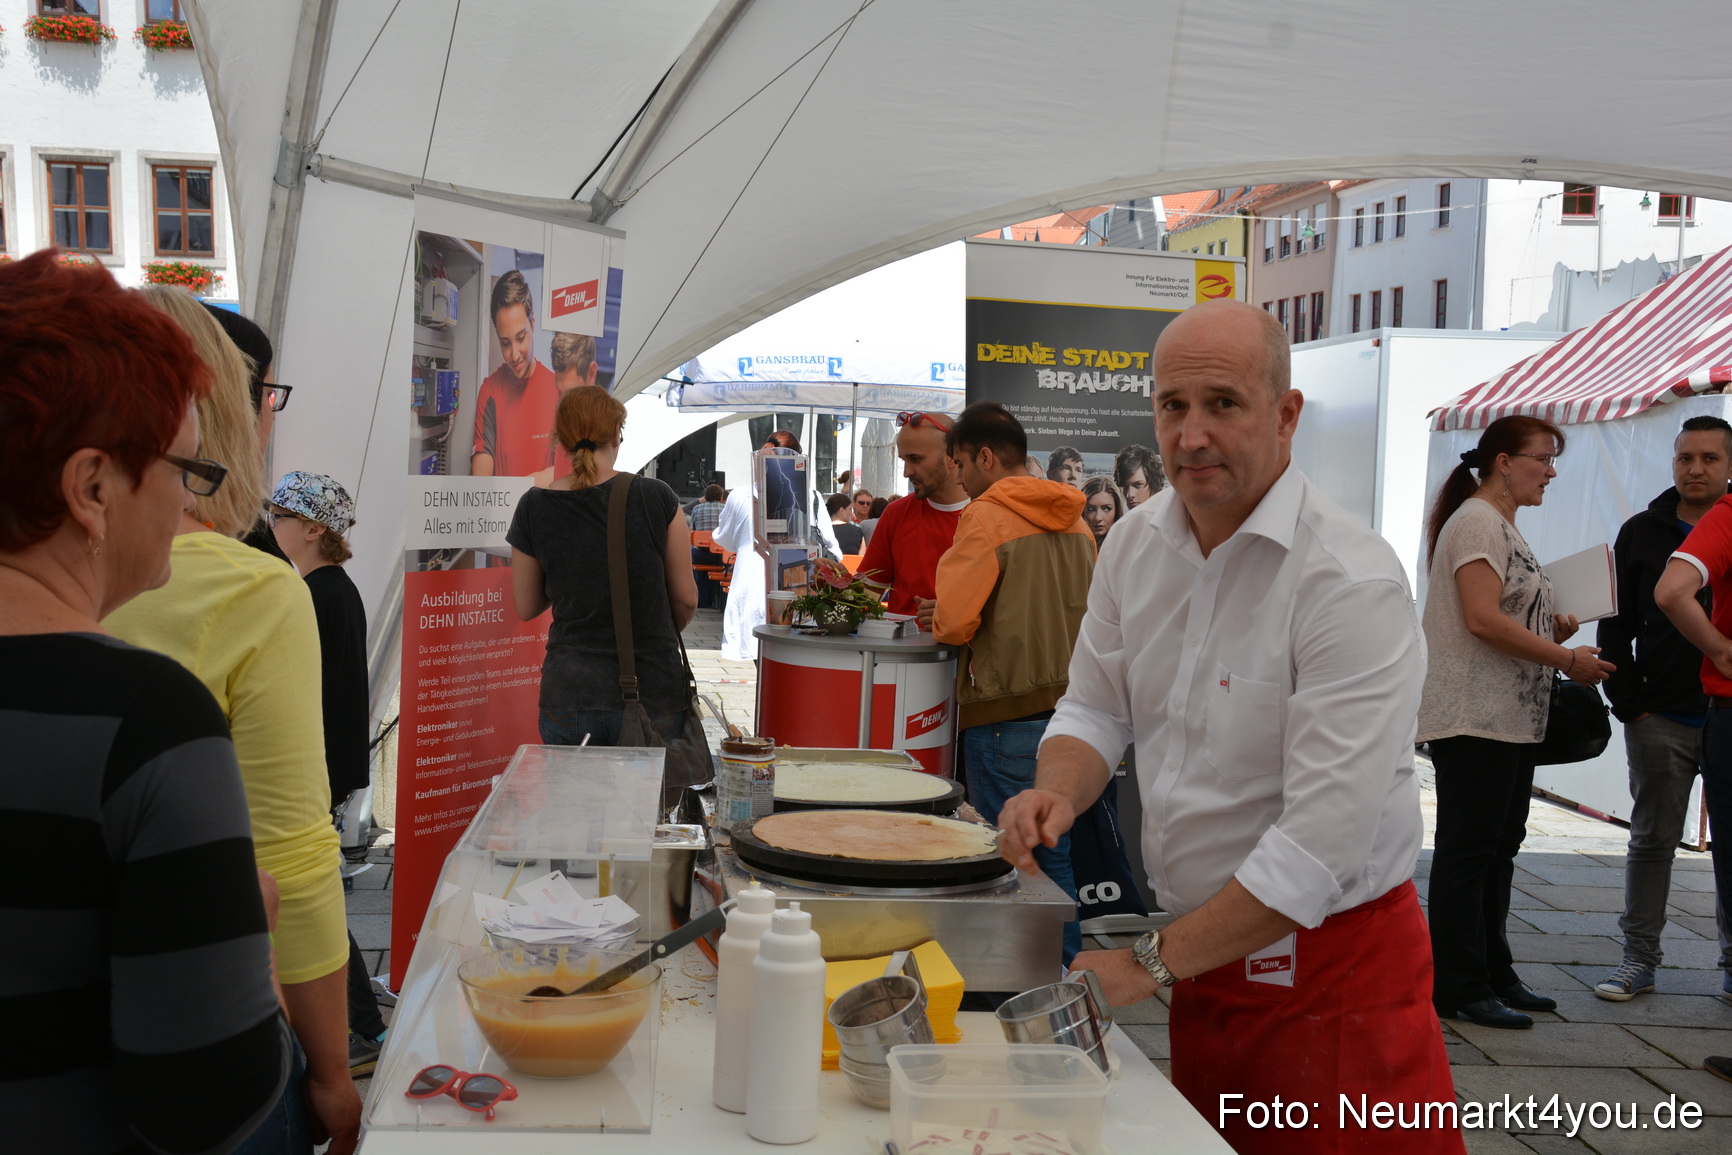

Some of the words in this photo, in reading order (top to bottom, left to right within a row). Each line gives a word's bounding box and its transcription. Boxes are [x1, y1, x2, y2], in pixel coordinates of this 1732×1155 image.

[1136, 282, 1190, 290] Informationstechnik
[1150, 290, 1190, 298] Neumarkt/Opf.
[564, 290, 586, 308] DEHN
[977, 342, 1057, 366] DEINE
[1063, 347, 1150, 371] STADT
[1020, 405, 1040, 413] ständig
[1050, 406, 1090, 416] Hochspannung.
[424, 492, 458, 507] DEHN
[463, 492, 510, 507] INSTATEC
[424, 518, 451, 534] Alles
[456, 518, 474, 534] mit
[421, 590, 484, 608] Ausbildung
[487, 588, 502, 602] bei
[420, 612, 454, 630] DEHN
[458, 608, 504, 626] INSTATEC
[419, 646, 428, 654] Du
[430, 644, 450, 653] suchst
[451, 642, 463, 651] eine
[464, 640, 487, 650] Aufgabe,
[488, 638, 496, 646] die
[497, 636, 511, 646] unter
[512, 634, 536, 644] anderem
[419, 658, 430, 667] und
[432, 656, 447, 666] viele
[448, 652, 486, 664] Möglichkeiten
[486, 648, 513, 659] verspricht?
[418, 678, 439, 687] Werde
[440, 676, 450, 684] Teil
[452, 674, 466, 684] eines
[466, 672, 484, 683] großen
[486, 670, 501, 678] Teams
[502, 667, 512, 676] und
[514, 665, 530, 674] erlebe
[531, 664, 540, 672] die
[418, 692, 428, 700] der
[430, 685, 478, 700] Tätigkeitsbereiche
[486, 682, 502, 690] einem
[417, 720, 458, 734] Elektroniker
[922, 710, 942, 728] DEHN
[416, 736, 442, 746] Energie-
[443, 734, 454, 742] und
[455, 726, 495, 740] Gebäudetechnik
[416, 753, 457, 767] Elektroniker
[416, 768, 454, 780] Informations-
[456, 763, 465, 772] und
[415, 788, 450, 800] Kaufmann
[452, 783, 461, 792] für
[414, 814, 432, 824] Mehr
[434, 810, 448, 820] Infos
[457, 804, 477, 814] unserer
[1077, 881, 1121, 905] CO
[1260, 960, 1280, 970] DEHN
